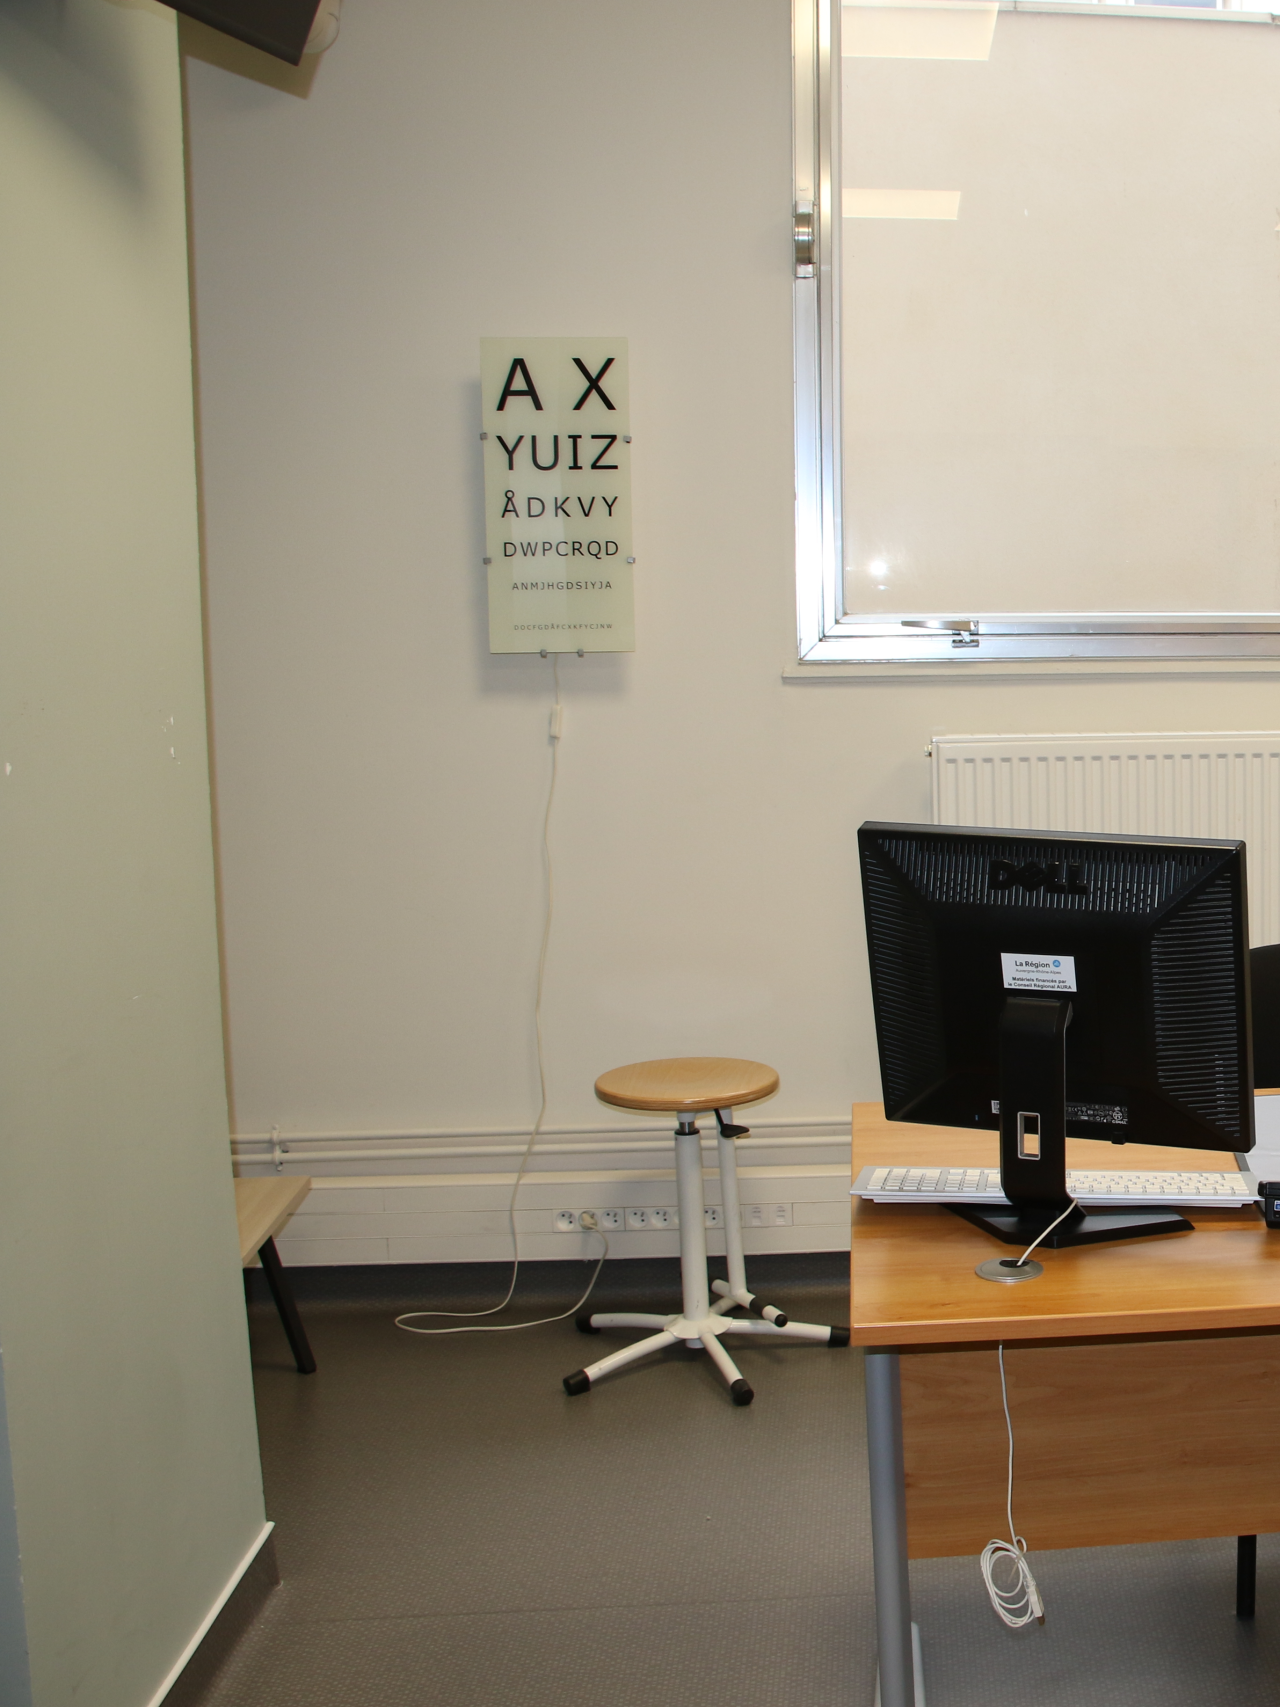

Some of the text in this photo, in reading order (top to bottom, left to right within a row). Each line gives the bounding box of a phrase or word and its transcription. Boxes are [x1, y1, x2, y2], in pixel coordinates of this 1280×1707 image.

[496, 357, 617, 411] A X
[495, 434, 619, 471] YUIZ
[501, 489, 618, 518] ÅDKVY
[503, 540, 619, 559] DWPCRQD
[511, 581, 612, 591] ANMJHGDSIYJA
[989, 859, 1088, 895] DELL
[1025, 960, 1050, 968] Région
